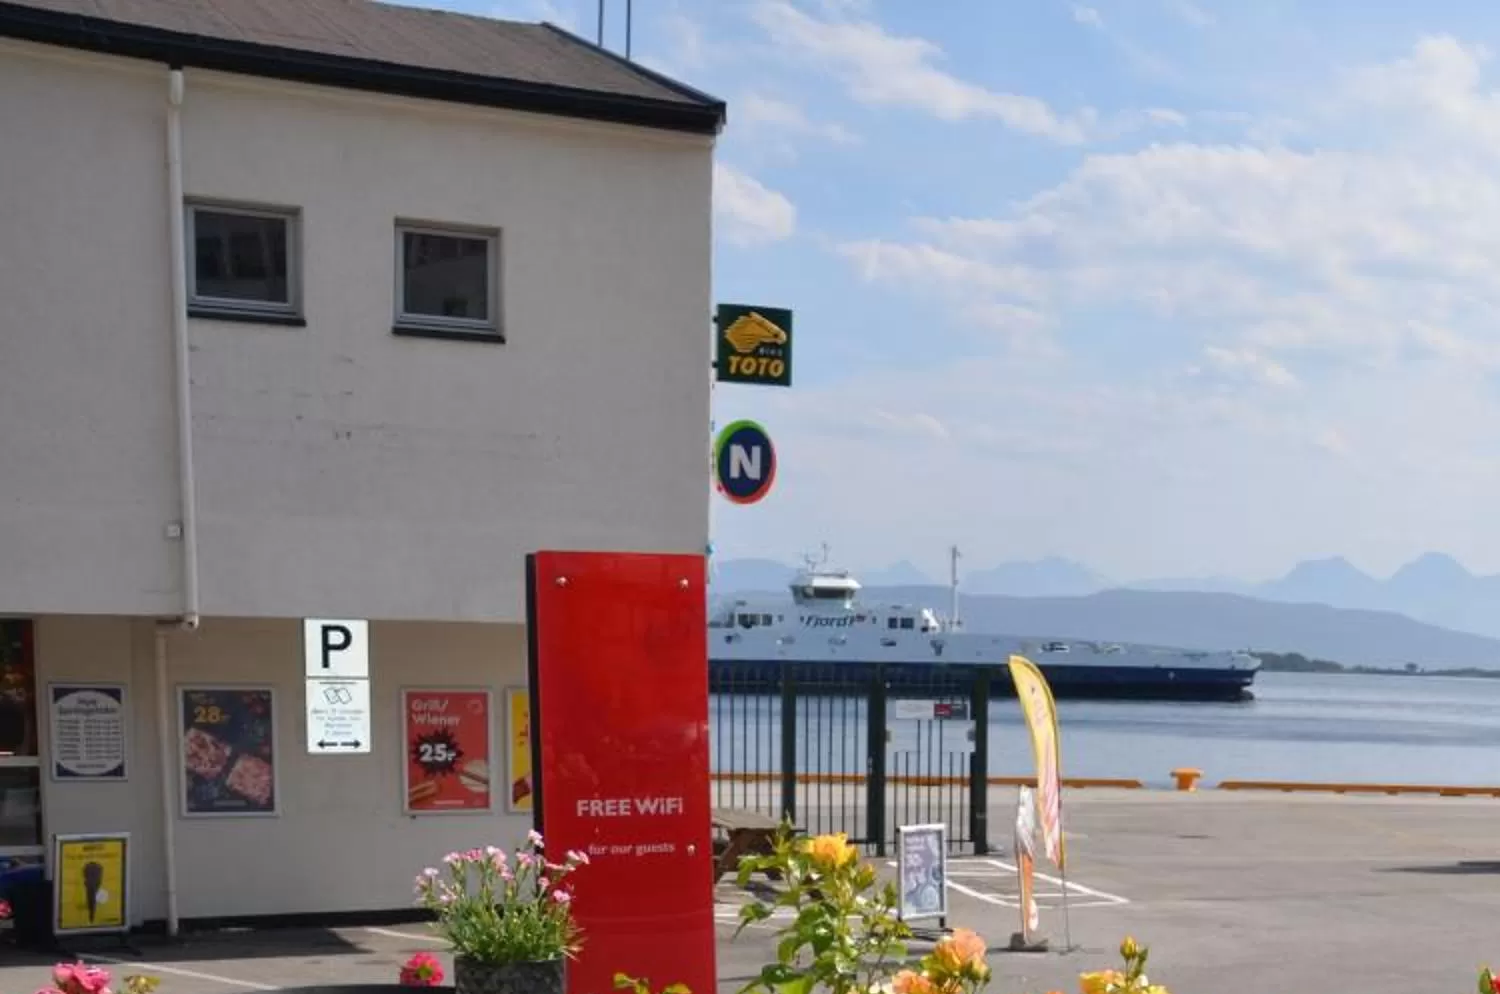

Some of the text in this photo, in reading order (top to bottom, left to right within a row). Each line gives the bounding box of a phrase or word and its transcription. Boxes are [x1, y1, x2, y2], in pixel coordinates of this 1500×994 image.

[727, 355, 785, 377] TOTO
[729, 443, 762, 480] N
[321, 623, 353, 669] P
[411, 712, 461, 727] Wiener
[576, 796, 684, 817] FREE WiFi
[588, 842, 675, 857] for our guests
